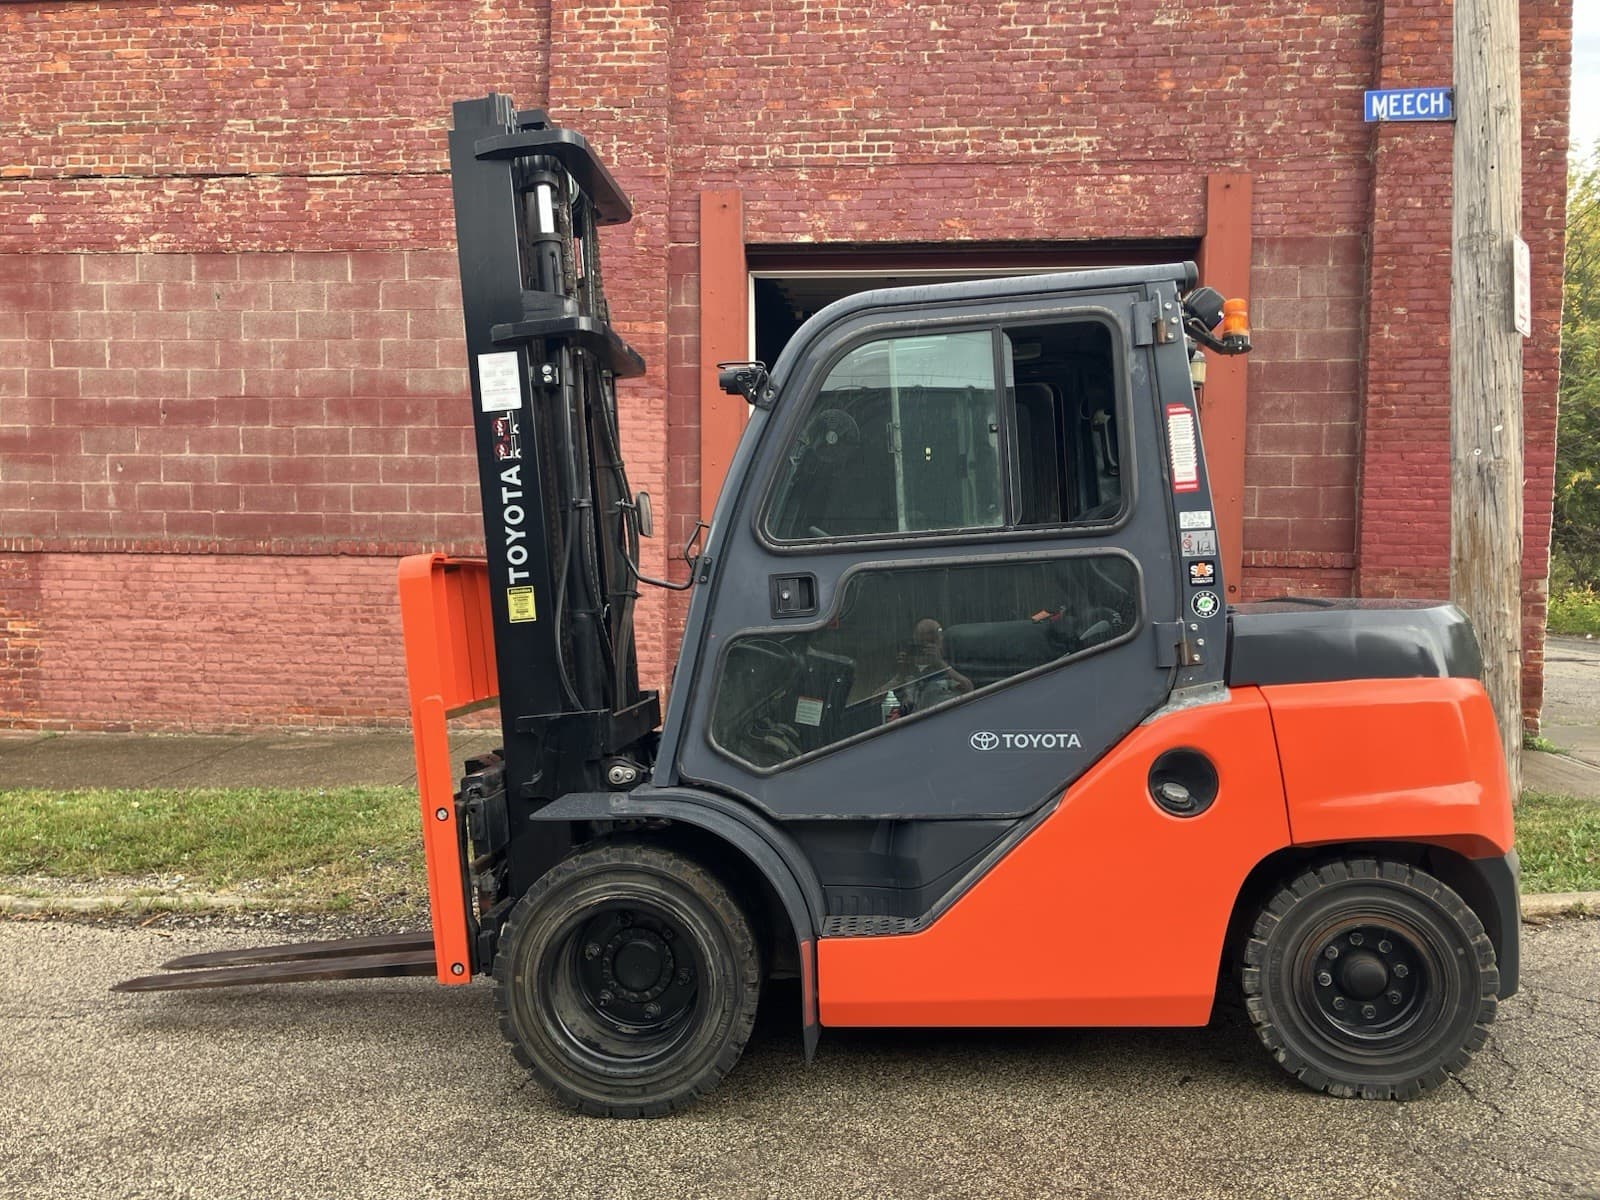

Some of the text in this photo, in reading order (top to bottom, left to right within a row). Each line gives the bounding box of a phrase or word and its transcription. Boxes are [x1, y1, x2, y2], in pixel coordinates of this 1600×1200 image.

[1372, 93, 1444, 118] MEECH
[501, 464, 529, 584] TOYOTA
[1190, 563, 1214, 577] SAS
[1002, 734, 1082, 748] TOYOTA
